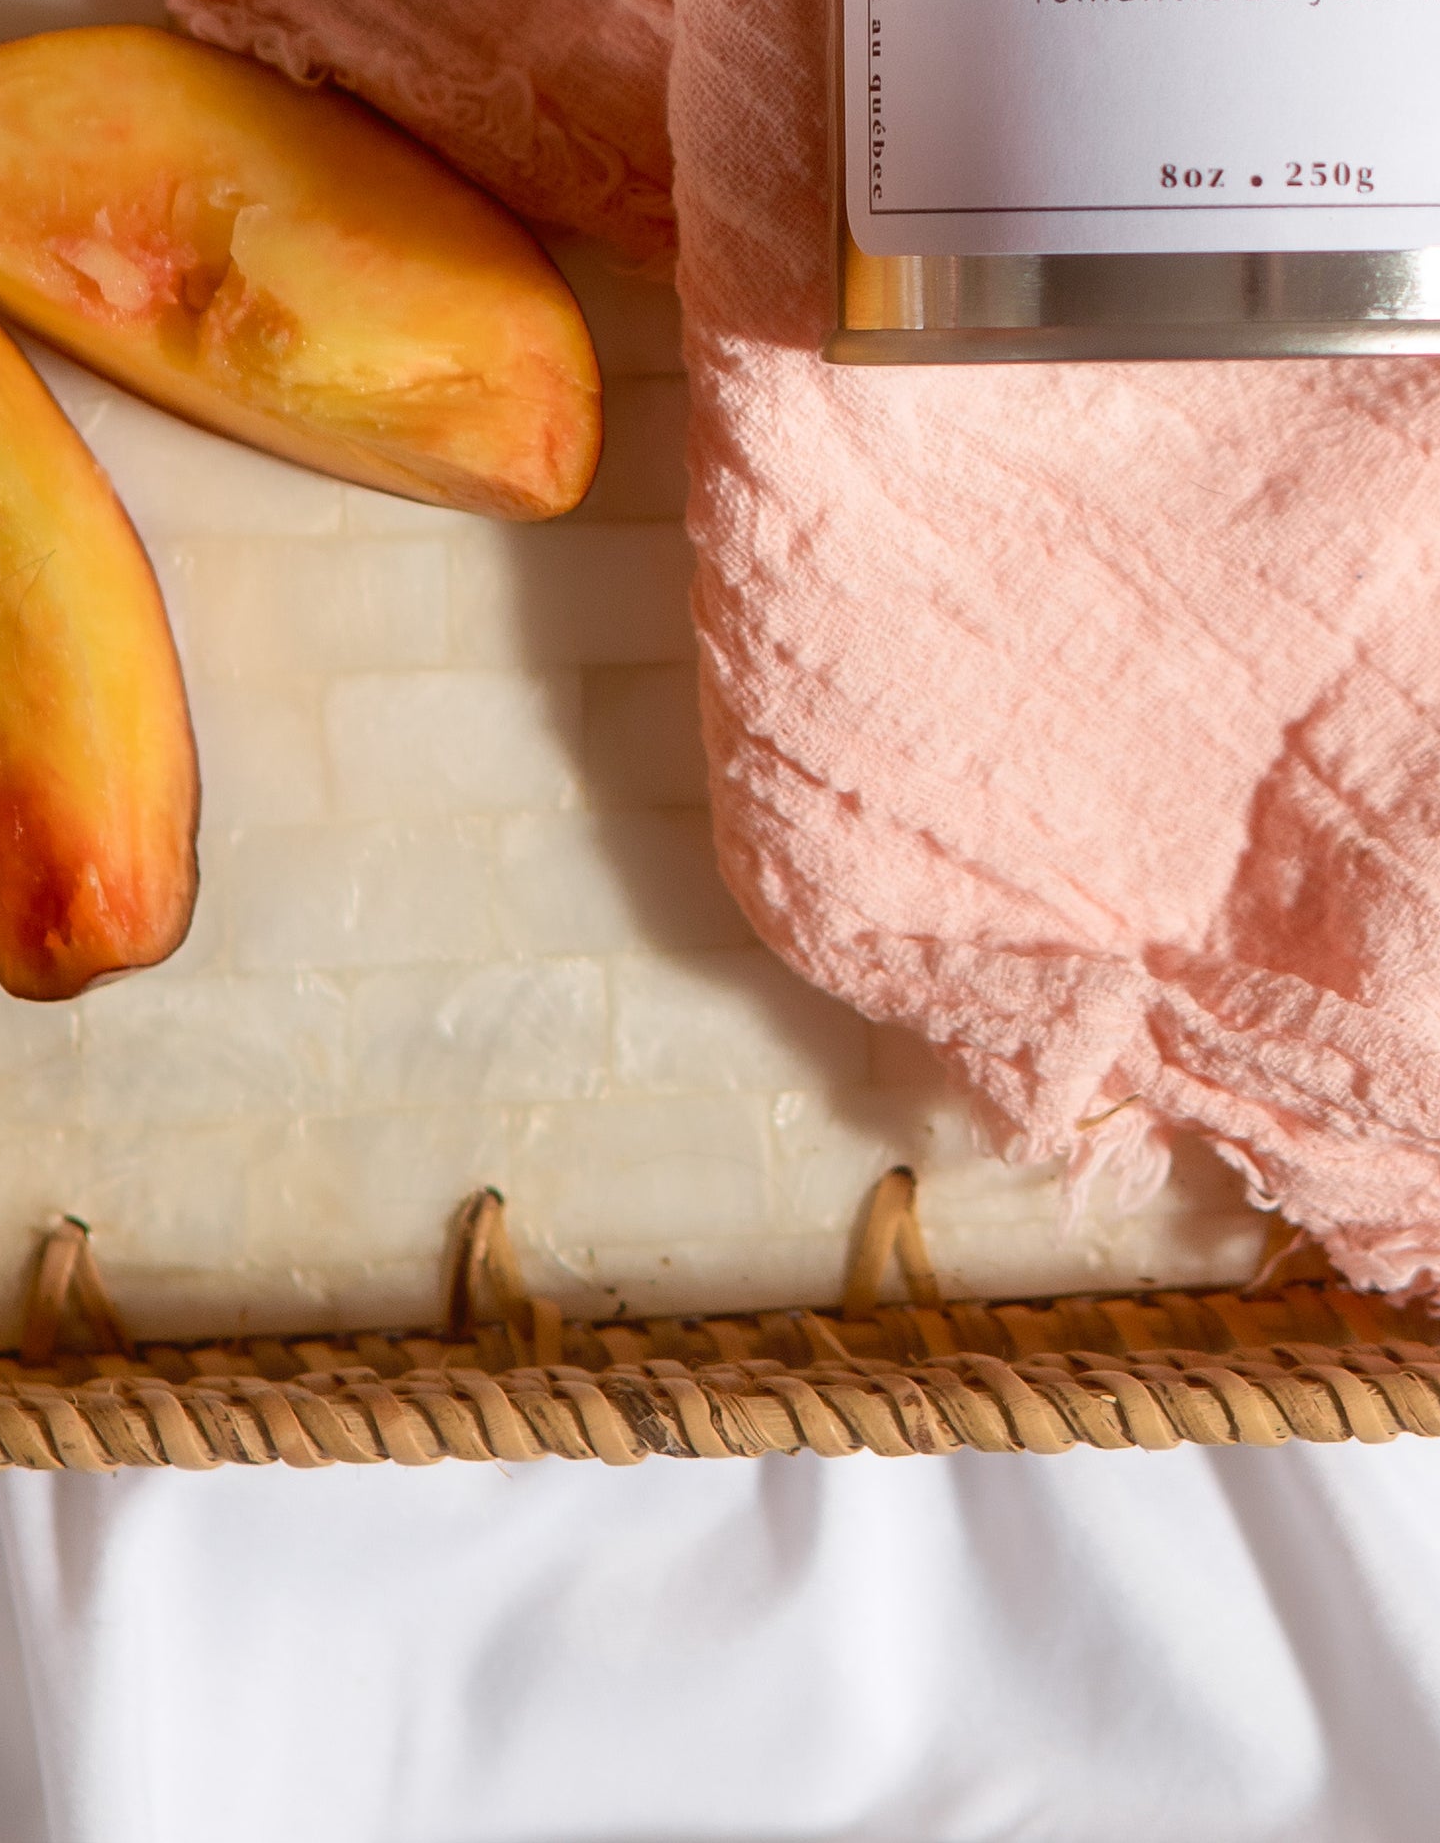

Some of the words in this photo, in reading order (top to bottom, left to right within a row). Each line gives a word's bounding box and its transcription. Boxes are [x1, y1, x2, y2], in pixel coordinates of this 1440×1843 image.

[871, 18, 883, 58] au
[869, 73, 887, 200] québec
[1160, 163, 1226, 190] 8oz
[1285, 161, 1376, 195] 250g
